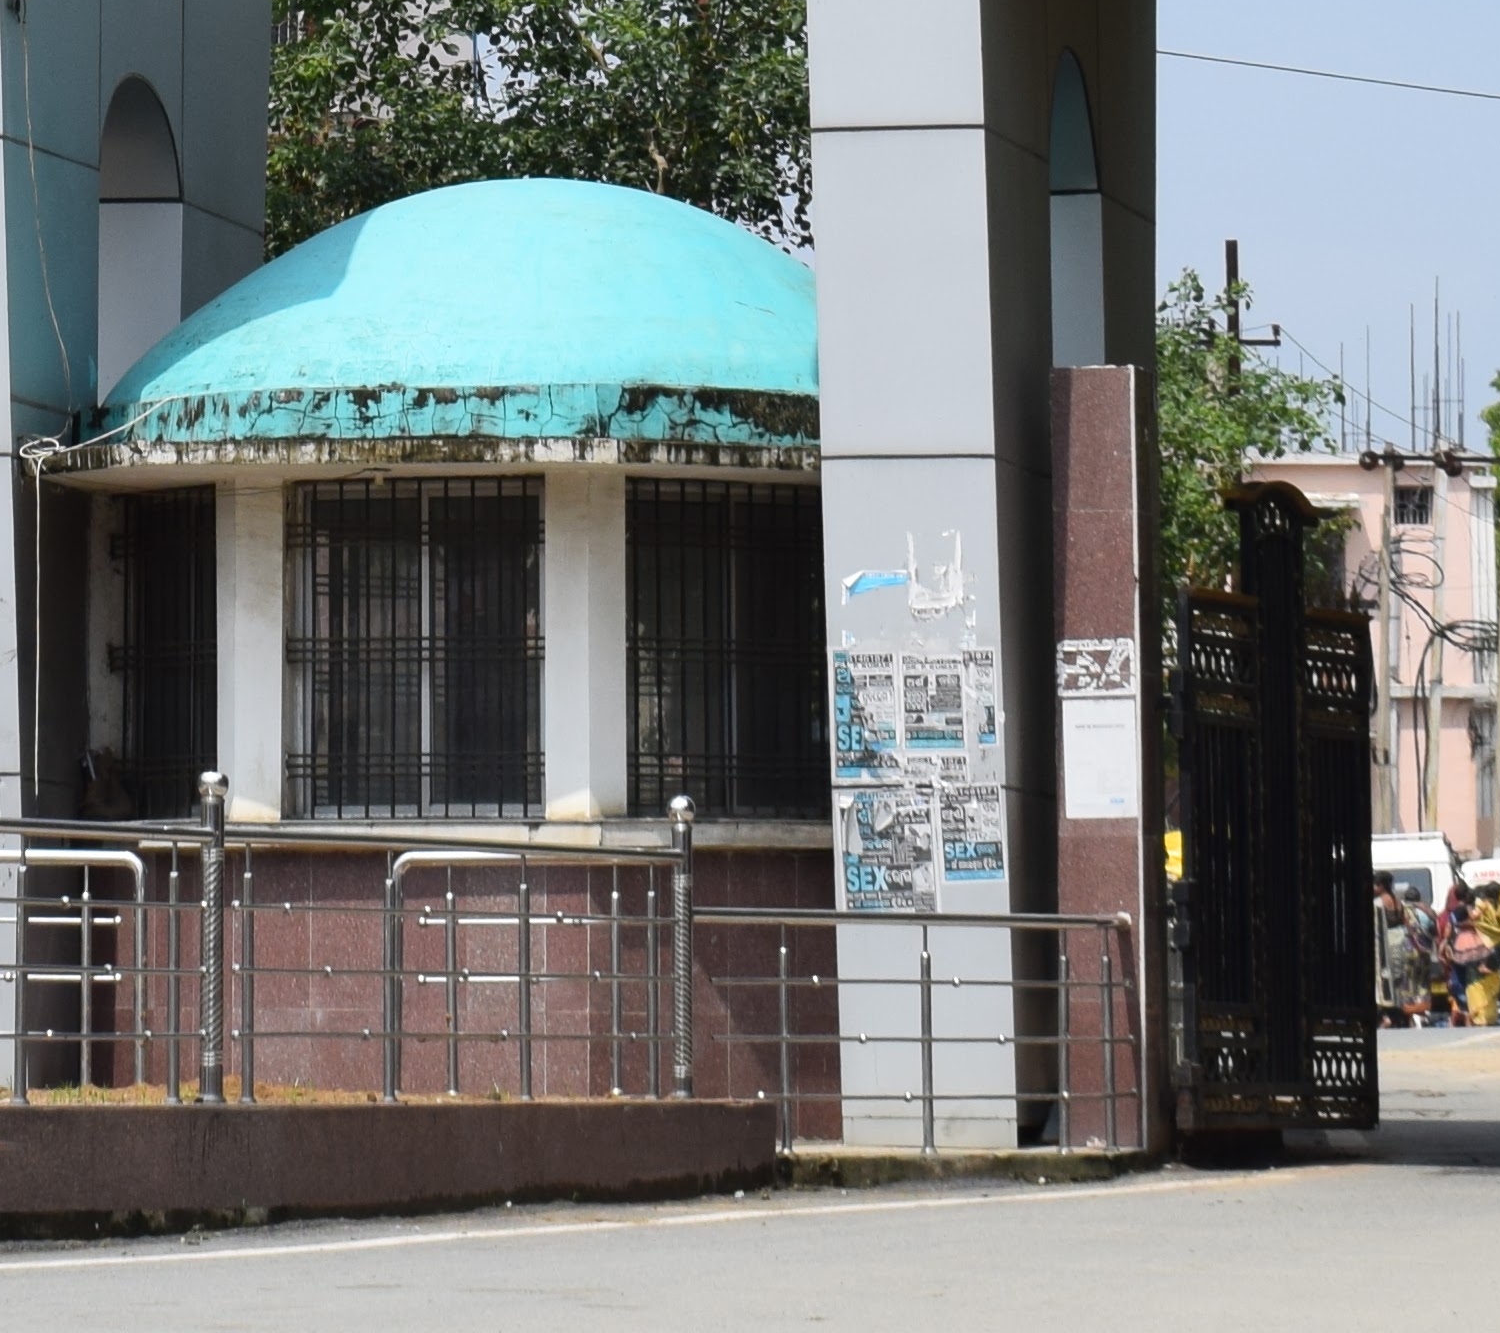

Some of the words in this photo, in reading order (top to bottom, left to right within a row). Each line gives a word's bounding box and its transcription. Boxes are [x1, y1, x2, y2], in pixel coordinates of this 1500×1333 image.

[837, 725, 865, 751] SE
[944, 841, 977, 859] SEX
[847, 865, 889, 892] SEX
